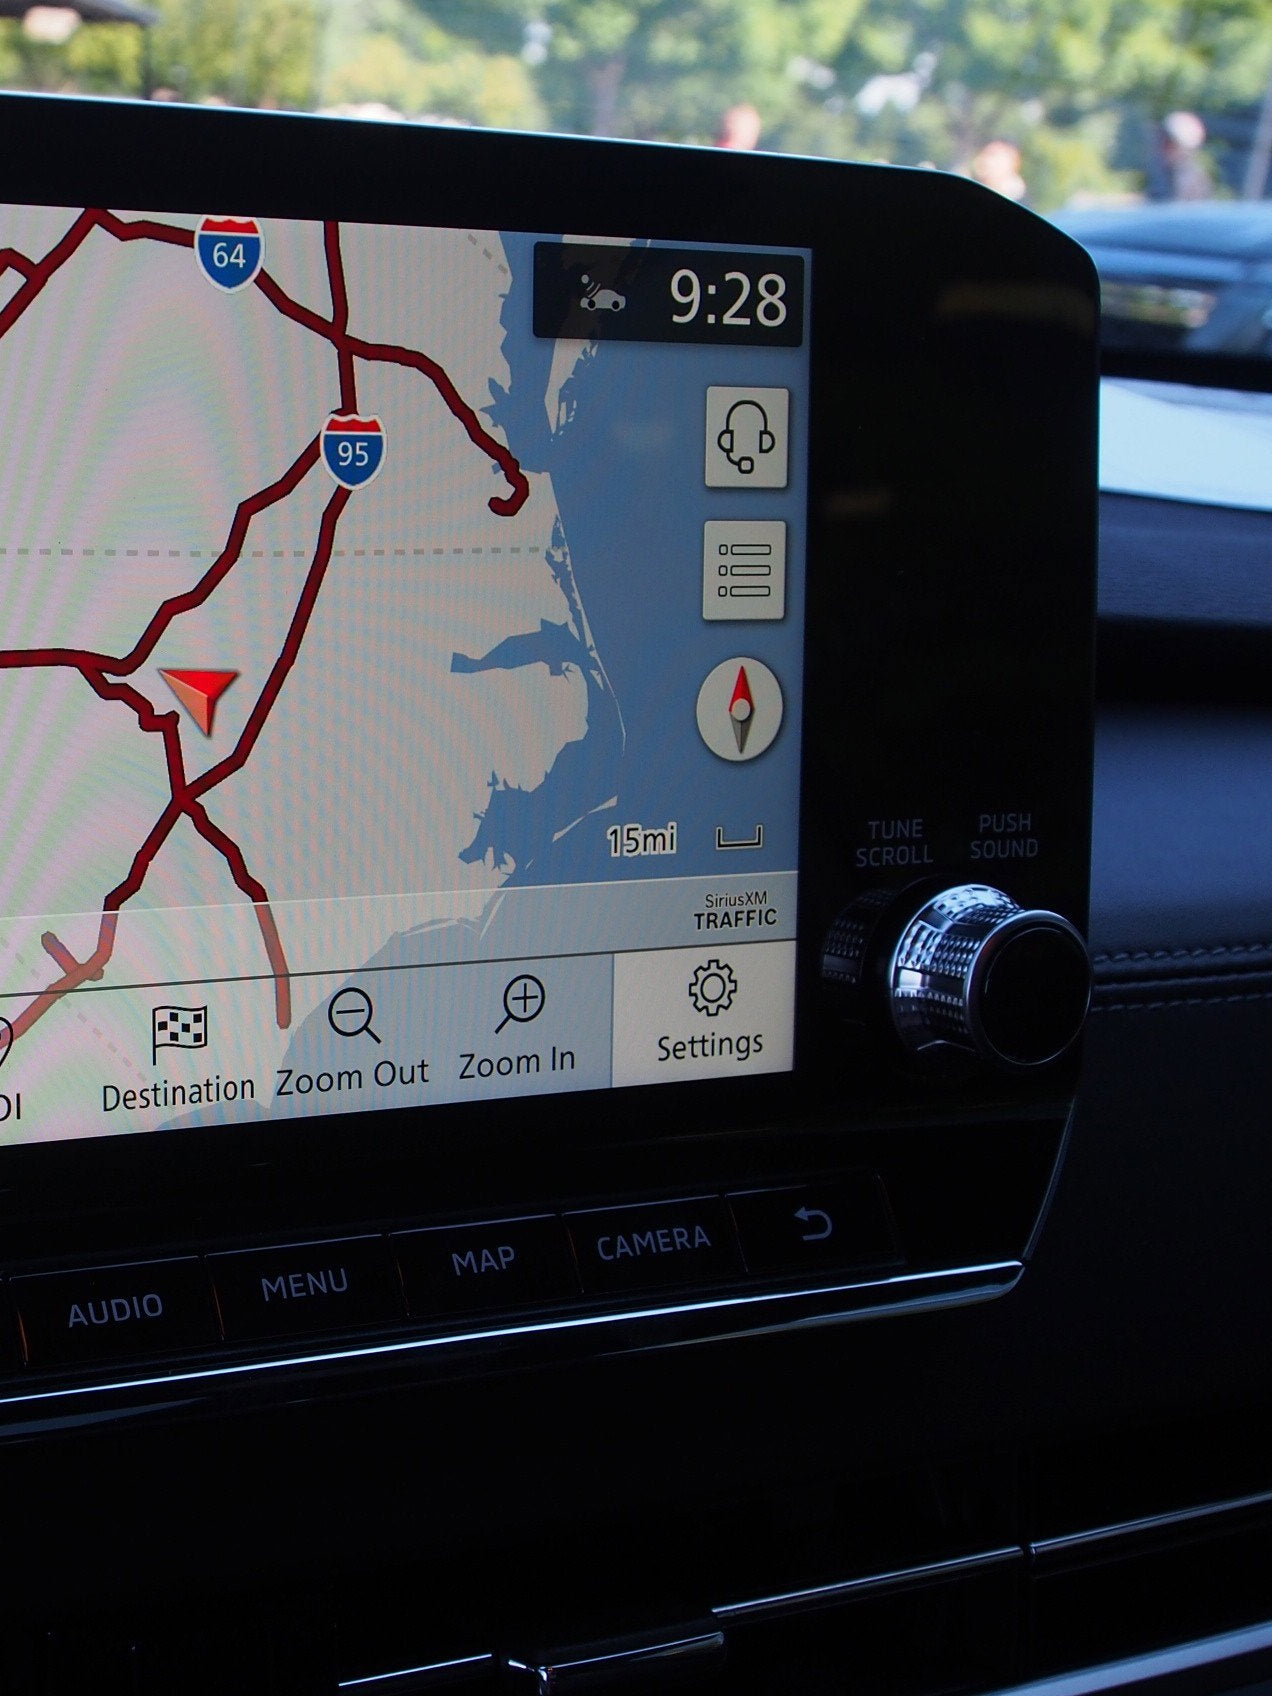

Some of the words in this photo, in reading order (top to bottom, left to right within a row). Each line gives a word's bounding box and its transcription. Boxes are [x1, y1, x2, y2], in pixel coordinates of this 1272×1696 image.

[211, 242, 248, 270] 64
[669, 268, 789, 328] 9:28
[336, 441, 370, 468] 95
[867, 818, 924, 840] TUNE
[978, 812, 1032, 834] PUSH
[606, 821, 679, 859] 15mi
[855, 844, 934, 868] SCROLL
[970, 838, 1039, 860] SOUND
[704, 890, 769, 909] SiriusXM
[693, 906, 778, 931] TRAFFIC
[656, 1028, 764, 1064] Settings
[276, 1065, 364, 1098] Zoom
[374, 1057, 430, 1088] Out
[459, 1049, 542, 1080] Zoom
[551, 1046, 576, 1072] In
[103, 1074, 255, 1112] Destination
[596, 1223, 712, 1262] CAMERA
[451, 1244, 516, 1277] MAP
[261, 1267, 349, 1303] MENU
[67, 1293, 164, 1330] AUDIO
